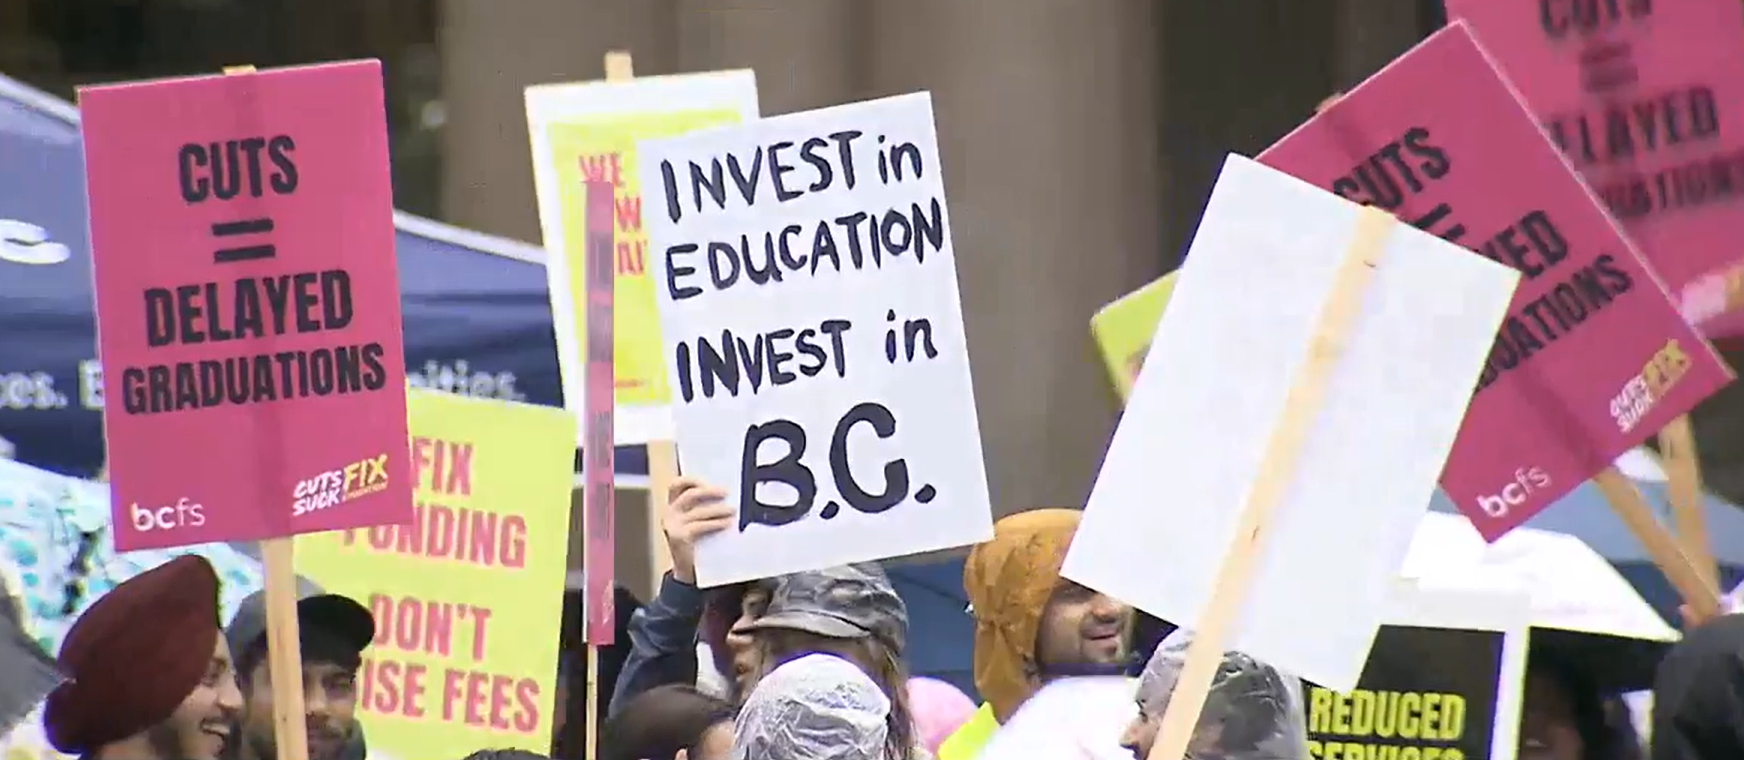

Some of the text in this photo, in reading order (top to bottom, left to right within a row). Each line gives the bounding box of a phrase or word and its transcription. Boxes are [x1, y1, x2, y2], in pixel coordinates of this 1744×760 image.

[178, 135, 299, 206] CUTS
[660, 130, 863, 223] INVEST
[877, 134, 923, 184] in
[665, 196, 943, 300] EDUCATION
[144, 269, 354, 347] DELAYED
[122, 342, 386, 415] GRADUATIONS
[676, 309, 938, 402] INVEST in
[293, 470, 342, 499] CUTS
[343, 454, 389, 492] FIX
[738, 402, 936, 533] B.C.
[1477, 466, 1552, 519] bcfs
[130, 498, 206, 532] bcfs
[369, 593, 491, 663] DON'T
[361, 660, 540, 733] ISE FEES
[1308, 686, 1467, 741] REDUCED
